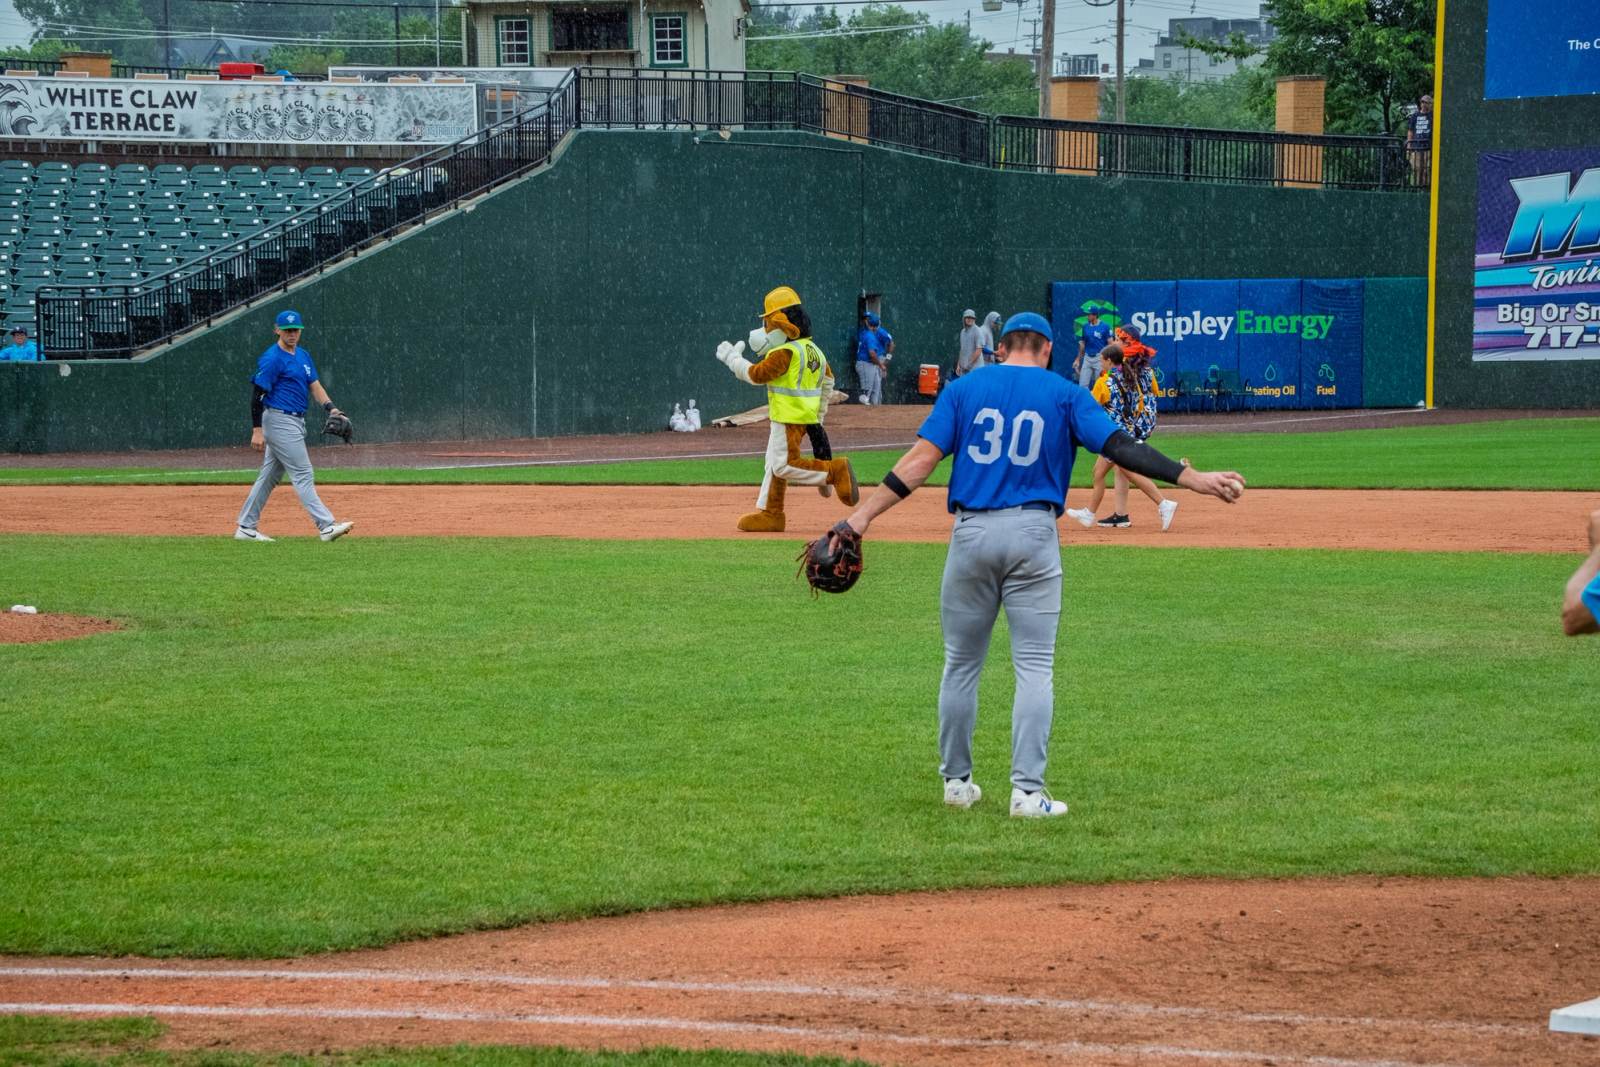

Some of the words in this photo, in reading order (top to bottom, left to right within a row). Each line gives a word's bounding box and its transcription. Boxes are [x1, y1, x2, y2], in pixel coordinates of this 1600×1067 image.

[1567, 39, 1591, 50] The
[46, 87, 124, 108] WHITE
[129, 89, 198, 109] CLAW
[70, 111, 176, 132] TERRACE
[1131, 310, 1235, 342] Shipley
[1235, 309, 1335, 340] Energy
[1497, 303, 1536, 326] Big
[1541, 303, 1570, 322] Or
[1523, 325, 1600, 349] 717-
[1282, 385, 1296, 395] Oil
[1316, 385, 1336, 396] Fuel
[967, 407, 1045, 467] 30
